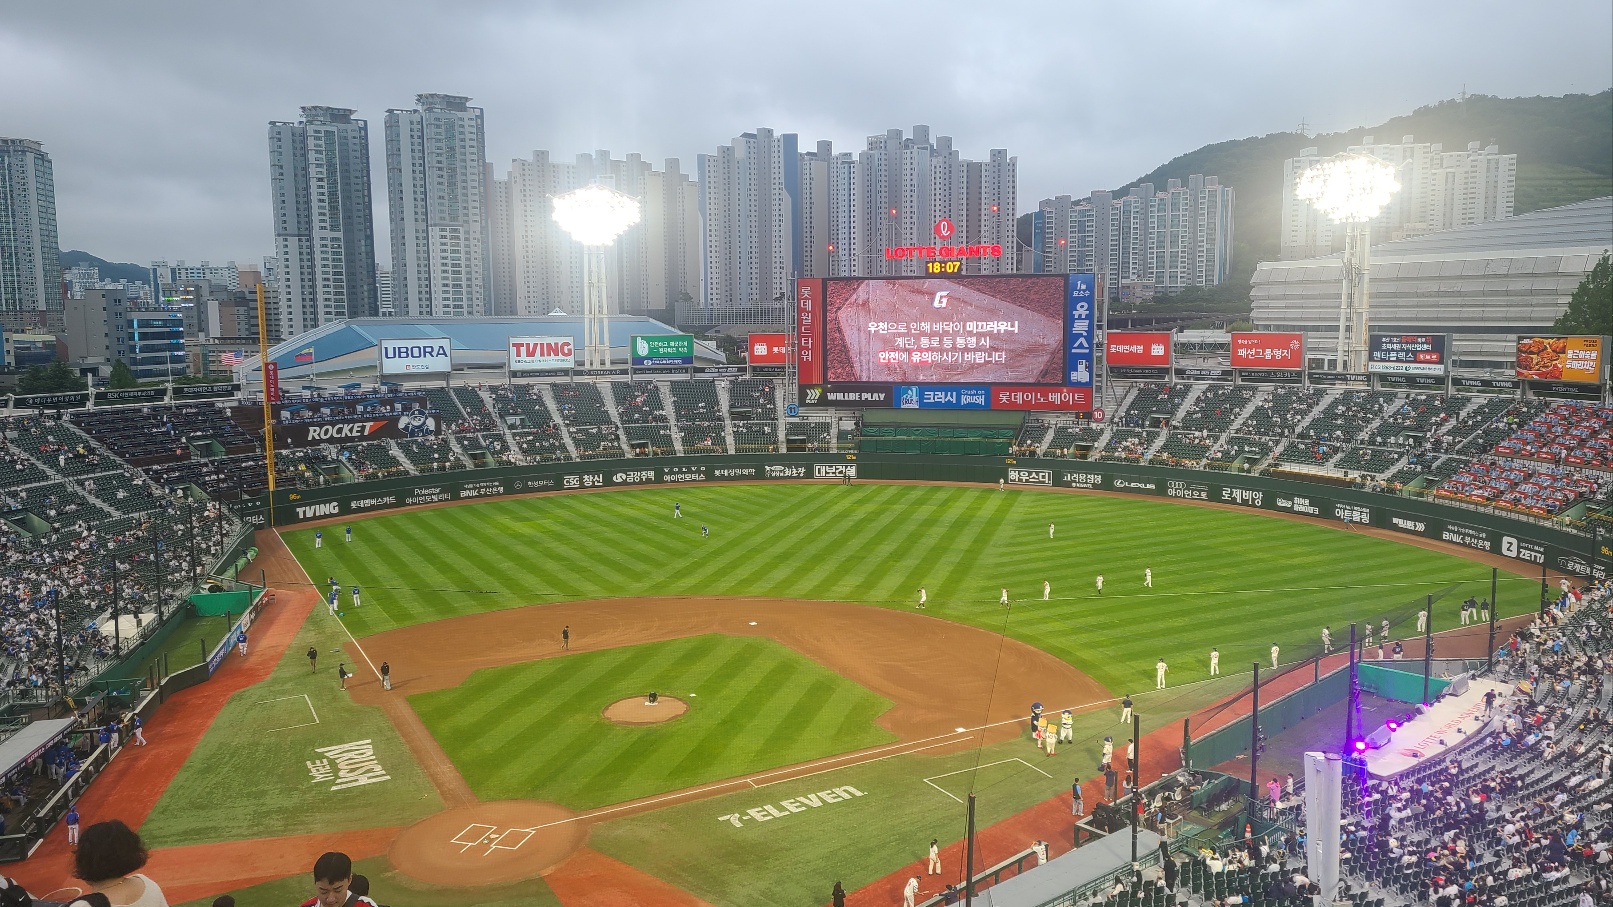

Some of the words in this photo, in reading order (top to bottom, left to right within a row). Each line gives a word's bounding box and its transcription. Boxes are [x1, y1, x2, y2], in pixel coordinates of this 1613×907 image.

[885, 246, 937, 260] LOTTE
[938, 245, 1003, 258] GIANTS
[927, 261, 961, 273] 18:07
[800, 286, 813, 362] 롯데월드타워
[868, 321, 908, 333] 우천으로
[910, 321, 931, 333] 인해
[933, 321, 963, 333] 바닥이
[966, 321, 1018, 333] 미끄러우니
[894, 337, 918, 349] 계단,
[920, 337, 941, 348] 통로
[942, 337, 953, 348] 등
[955, 337, 977, 348] 통행
[980, 337, 990, 348] 시
[1109, 344, 1144, 354] 롯데면세점
[384, 345, 448, 359] UBORA
[511, 341, 573, 358] TVING
[1237, 347, 1291, 360] 패션그룹형지
[1373, 350, 1415, 361] 펜타플렉스
[879, 351, 909, 363] 안전에
[911, 351, 962, 363] 유의하시기
[964, 351, 1006, 363] 바랍니다
[1461, 379, 1482, 387] TVING
[827, 392, 861, 401] WILLBE
[862, 392, 886, 401] PLAY
[923, 391, 957, 404] 크러시
[961, 394, 985, 405] KRUSH
[998, 391, 1086, 405] 롯데이노베이트
[307, 422, 374, 441] ROCKET
[626, 470, 655, 483] 금강주택
[815, 465, 856, 477] 대보건설
[527, 479, 555, 488] 한성모터스
[563, 476, 580, 486] CSG
[583, 474, 603, 486] 창신
[663, 473, 706, 482] 아이언모터스
[1063, 473, 1102, 484] 고려용접봉
[414, 487, 442, 496] Polestar
[1125, 481, 1156, 490] LEXUS
[460, 488, 479, 498] BNK
[480, 486, 504, 496] 부산은행
[1167, 488, 1209, 500] 아이언오토
[1221, 487, 1263, 506] 로제비앙
[350, 495, 397, 509] 롯데멤버스카드
[405, 492, 451, 505] 아이언모빌리티
[296, 501, 339, 519] TVING
[1335, 508, 1370, 524] 아트몰링
[1442, 531, 1464, 544] BNK
[1464, 535, 1491, 550] 부산은행
[314, 738, 392, 791] KRUSH
